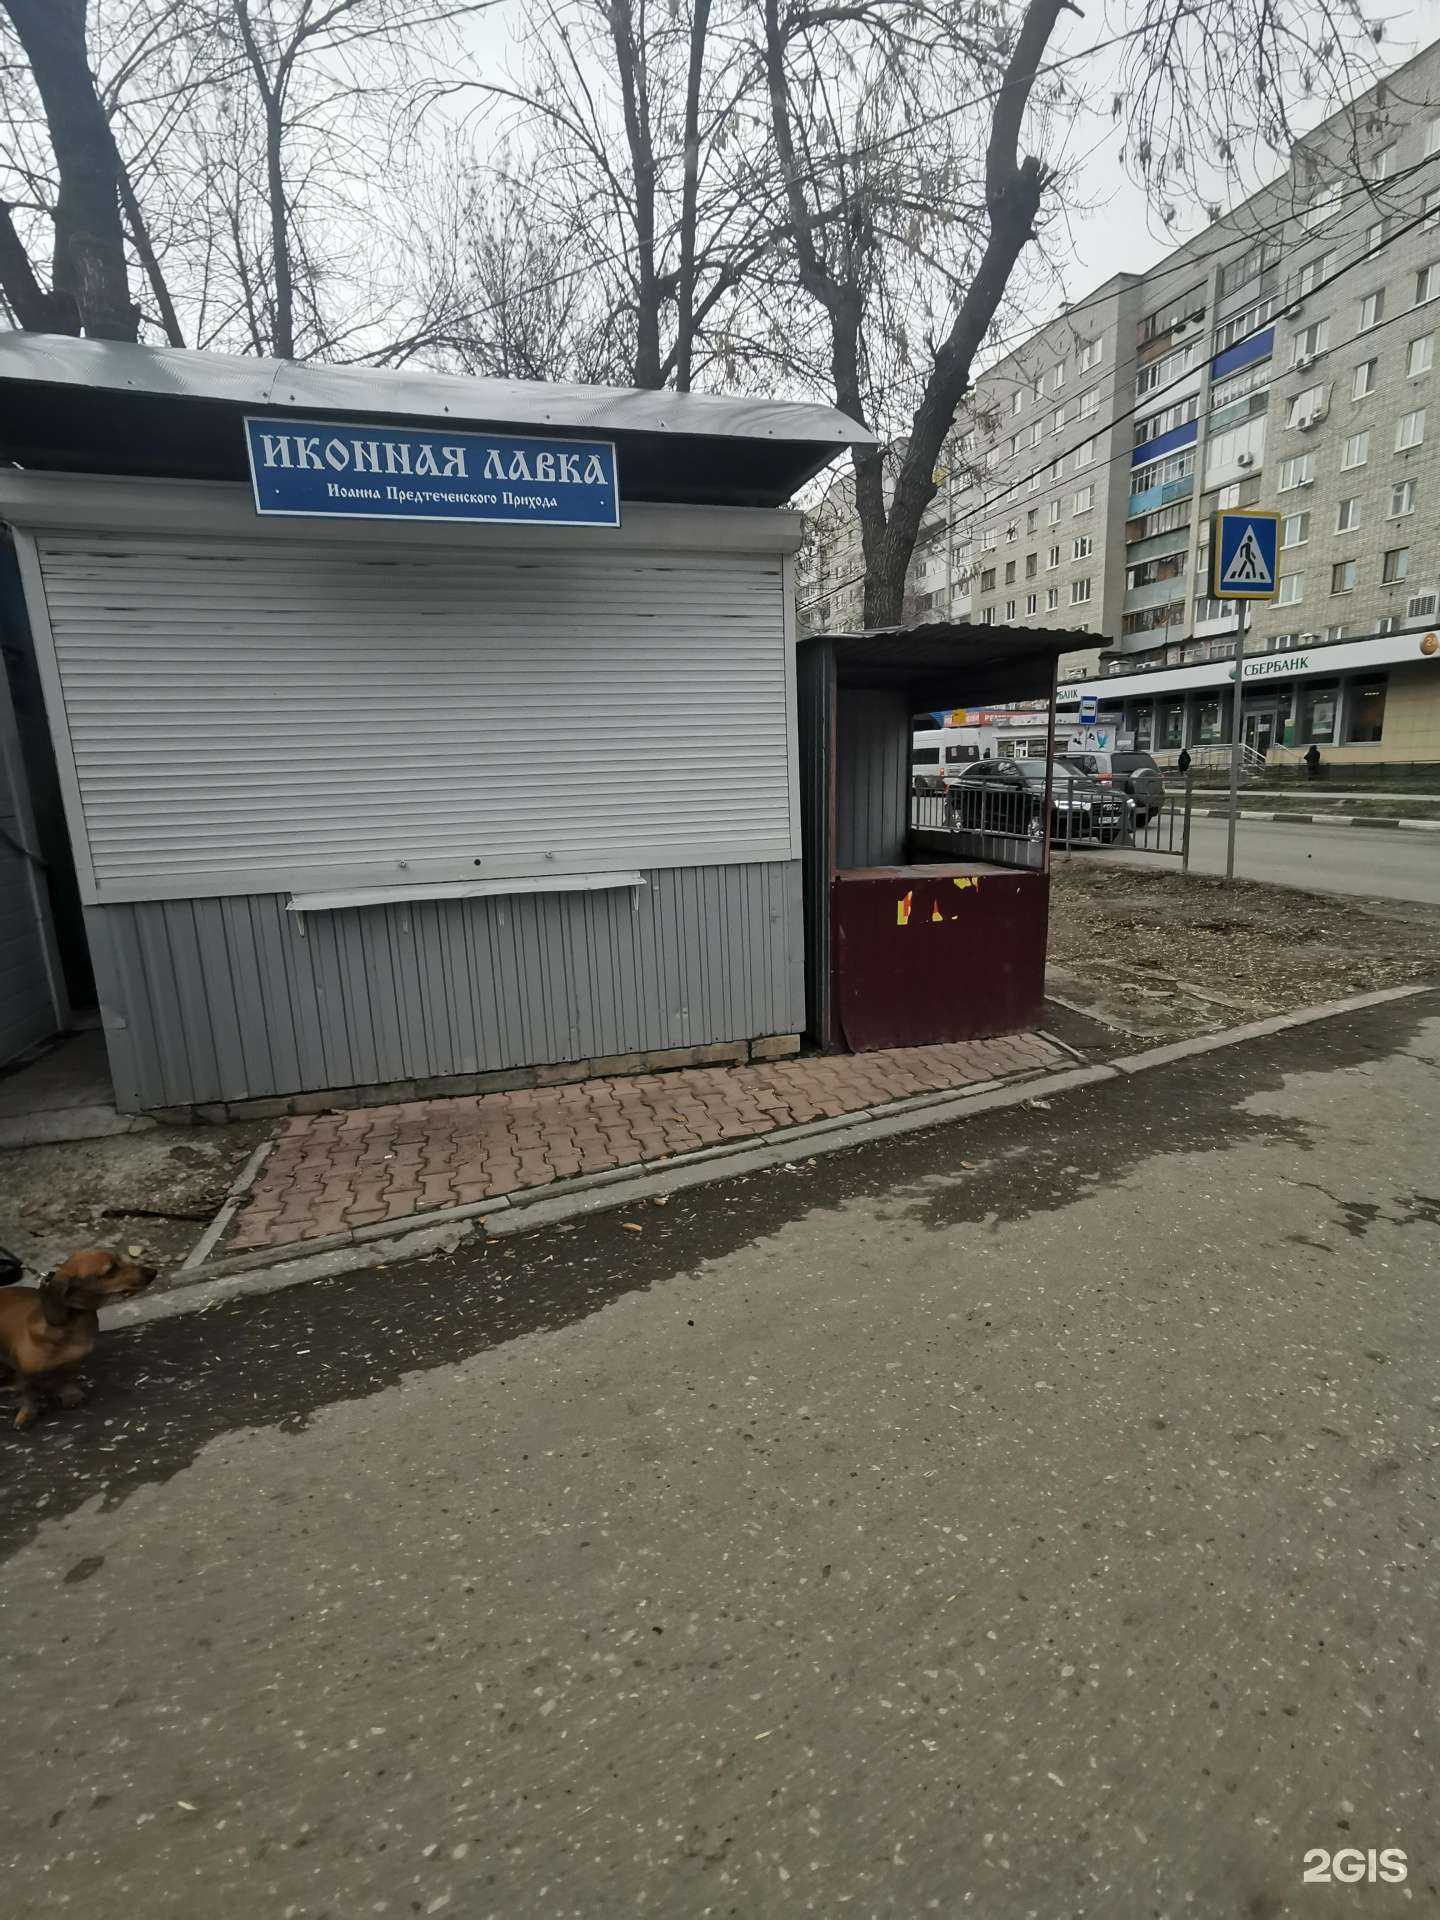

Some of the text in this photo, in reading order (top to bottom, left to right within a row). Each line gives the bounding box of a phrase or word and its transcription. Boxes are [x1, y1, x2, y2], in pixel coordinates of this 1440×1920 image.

[259, 434, 608, 485] ИКОННАЯ ЛАВКА
[327, 482, 558, 510] Иоанна Предтеченского Прихода
[1244, 656, 1309, 676] СБЕРБАНК
